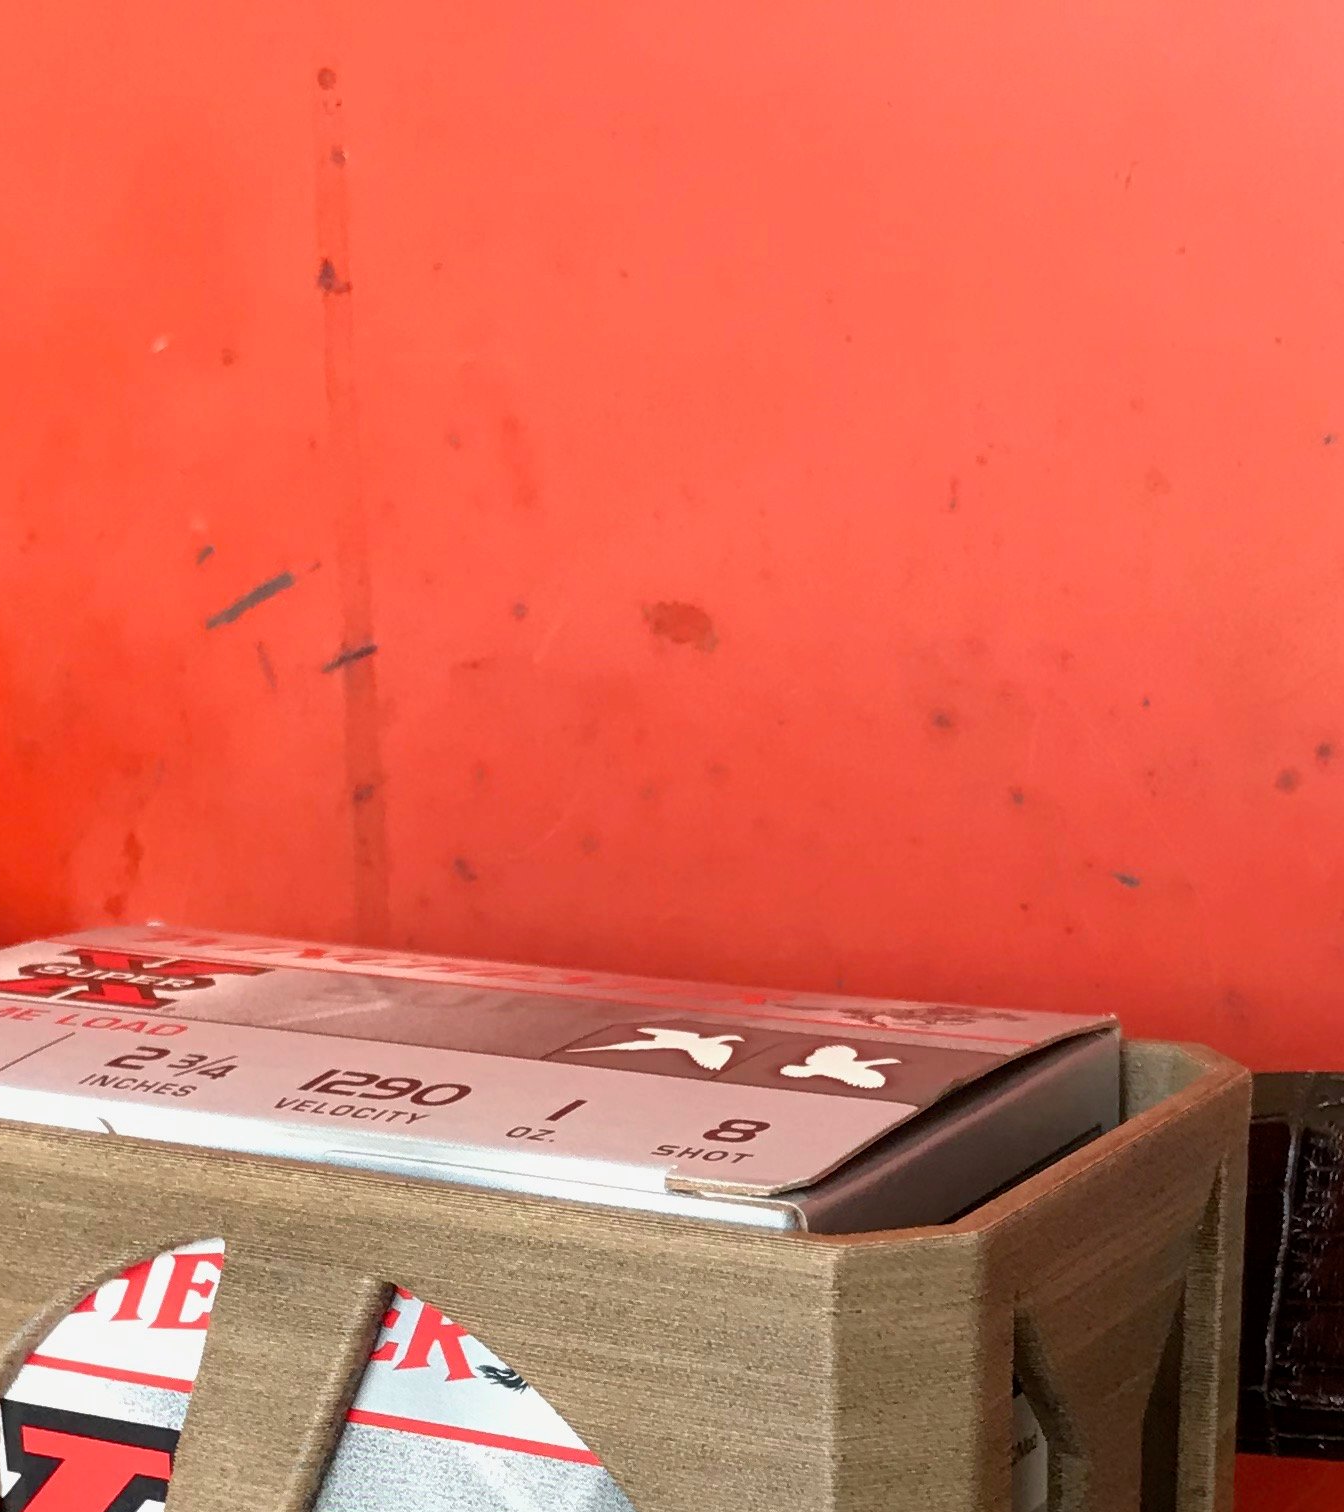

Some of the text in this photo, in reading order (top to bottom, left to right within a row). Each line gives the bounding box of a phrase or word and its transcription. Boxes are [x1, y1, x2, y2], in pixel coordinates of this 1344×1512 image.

[36, 963, 196, 990] SUPER
[54, 1013, 189, 1037] LOAD
[104, 1045, 170, 1071] 2
[78, 1072, 197, 1098] INCHES
[297, 1068, 472, 1107] 1290
[274, 1096, 430, 1125] VELOCITY
[505, 1125, 557, 1143] OZ.
[702, 1118, 771, 1143] 8
[651, 1143, 754, 1164] SHOT
